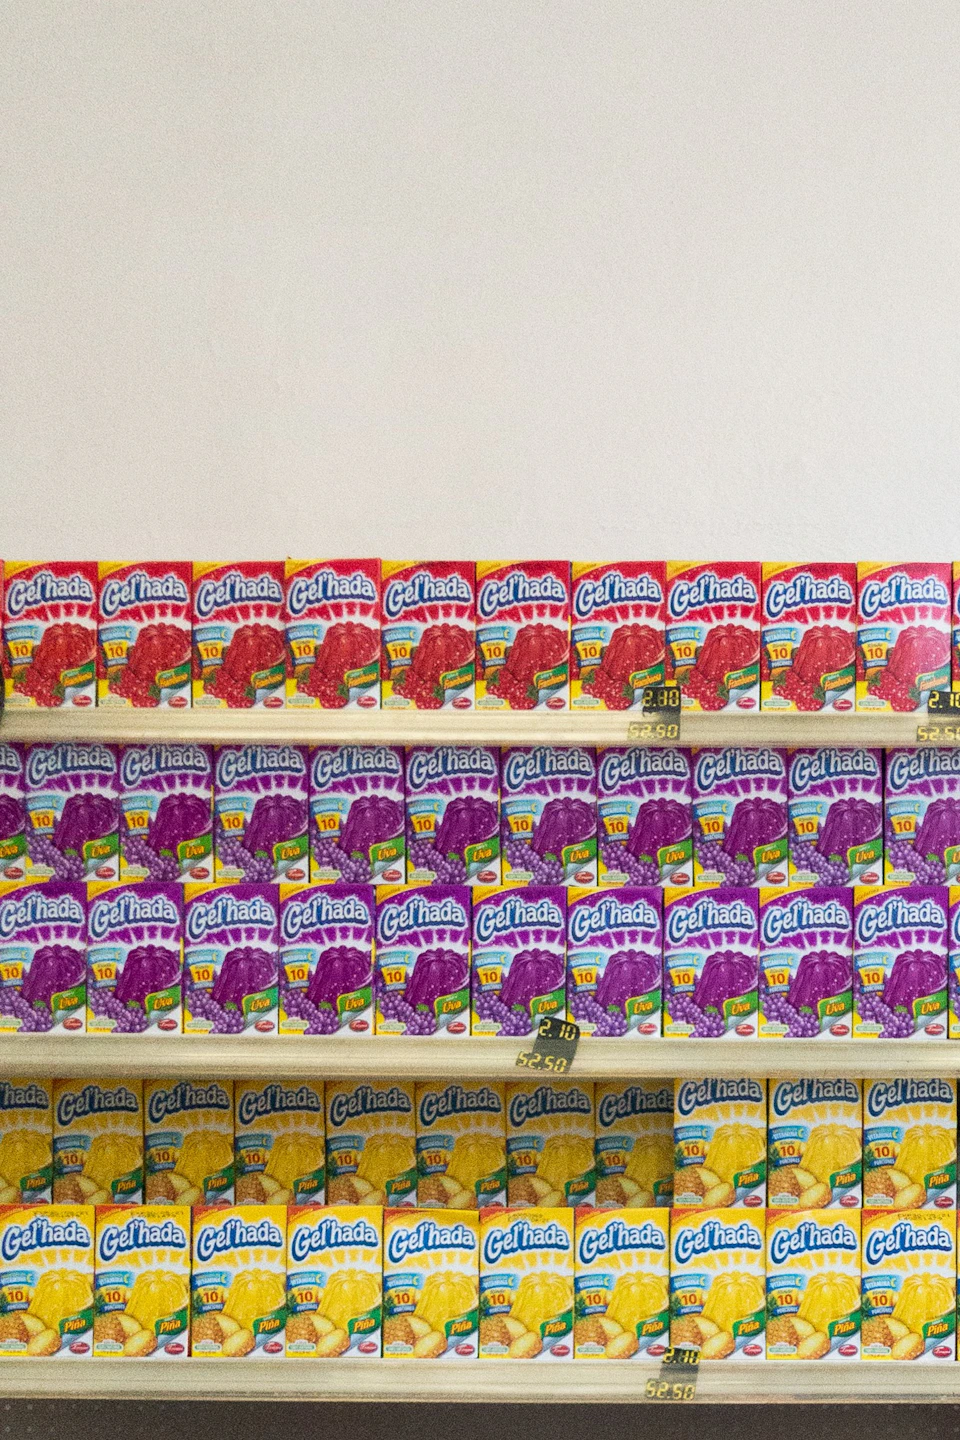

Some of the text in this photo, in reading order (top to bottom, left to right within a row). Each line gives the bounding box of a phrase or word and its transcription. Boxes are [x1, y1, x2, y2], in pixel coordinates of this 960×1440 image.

[9, 573, 92, 614] Gel'hada
[290, 572, 373, 613] Gel'hada
[577, 574, 660, 615] Gel'hada
[768, 575, 851, 616] Gel'hada
[773, 648, 788, 660] 10
[514, 820, 529, 831] 10
[378, 847, 397, 861] Uva
[856, 849, 875, 863] Uva
[91, 893, 177, 936] Gel'hada
[283, 894, 369, 937] Gel'hada
[477, 897, 563, 940] Gel'hada
[859, 898, 945, 941] Gel'hada
[290, 969, 305, 981] 10
[539, 1000, 558, 1013] Uva
[922, 1001, 941, 1014] Uva
[538, 1020, 577, 1040] 2.10
[516, 1051, 567, 1073] 52.50
[684, 1145, 699, 1156] 10
[101, 1219, 184, 1261] Gel'hada
[292, 1218, 378, 1261] Gel'hada
[677, 1221, 760, 1263] Gel'hada
[394, 1293, 410, 1305] 10
[353, 1317, 374, 1333] Piña
[738, 1320, 759, 1336] Piña
[646, 1381, 695, 1400] 52.50
